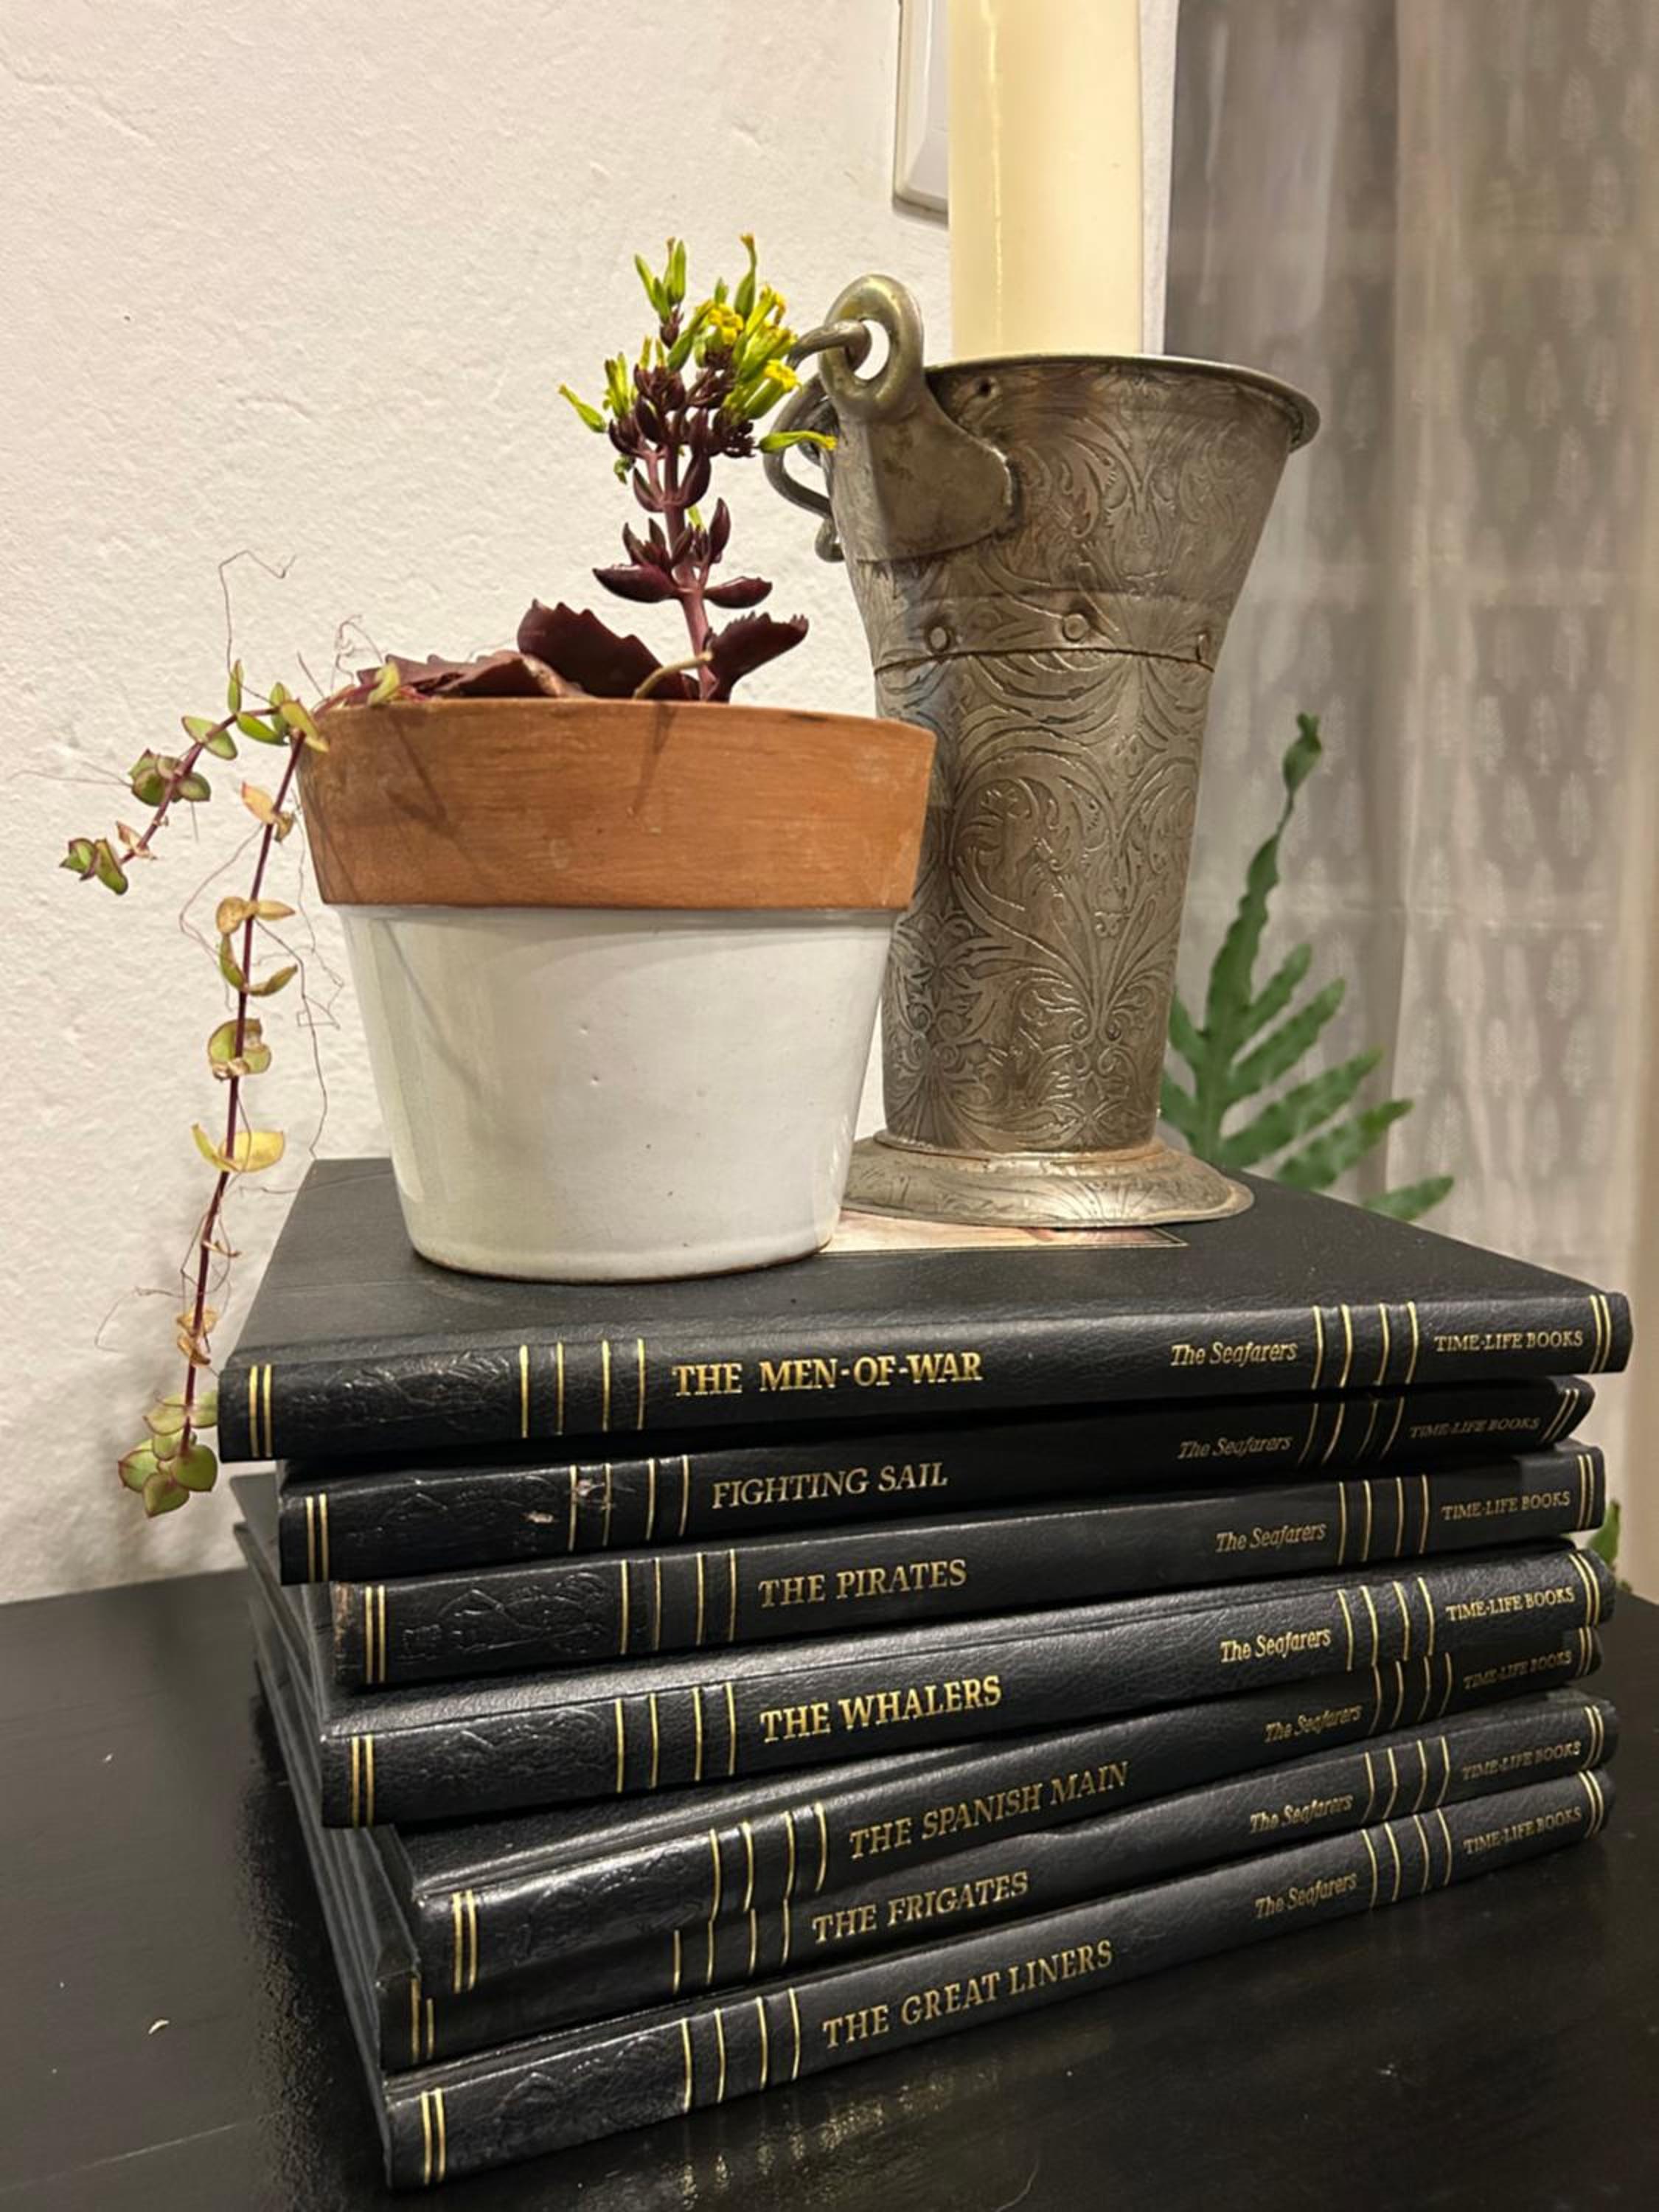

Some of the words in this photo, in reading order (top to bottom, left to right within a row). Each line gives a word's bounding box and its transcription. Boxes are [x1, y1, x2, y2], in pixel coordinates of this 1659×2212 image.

[1171, 1344, 1206, 1366] The
[1210, 1342, 1298, 1367] Seafarers
[1526, 1330, 1583, 1348] BOOKS
[672, 1363, 742, 1397] THE
[759, 1352, 983, 1391] MEN-OF-WAR
[1486, 1416, 1540, 1432] BOOKS
[1178, 1440, 1214, 1459] The
[1217, 1435, 1293, 1458] Seafarers
[712, 1468, 869, 1510] FIGHTING
[878, 1462, 948, 1492] SAIL
[1520, 1491, 1571, 1512] BOOKS
[1216, 1532, 1247, 1553] The
[1250, 1523, 1326, 1548] Seafarers
[759, 1575, 825, 1607] THE
[836, 1559, 967, 1600] PIRATES
[1524, 1587, 1575, 1610] BOOKS
[1220, 1640, 1251, 1664] The
[1255, 1628, 1331, 1659] Seafarers
[1528, 1650, 1573, 1674] BOOKS
[760, 1703, 831, 1743] THE
[838, 1675, 1002, 1731] WHALERS
[1264, 1721, 1293, 1743] The
[1296, 1705, 1362, 1734] Seafarers
[1534, 1741, 1581, 1765] BOOKS
[849, 1820, 912, 1860] THE
[922, 1783, 1044, 1842] SPANISH
[1050, 1761, 1130, 1806] MAIN
[1250, 1812, 1279, 1834] The
[1283, 1794, 1353, 1825] Seafarers
[1537, 1806, 1582, 1833] BOOKS
[813, 1905, 877, 1944] THE
[887, 1871, 1029, 1927] FRIGATES
[1255, 1895, 1284, 1918] The
[1287, 1872, 1357, 1907] Seafarers
[824, 2006, 890, 2049] THE
[901, 1972, 1002, 2025] GREAT
[1009, 1940, 1113, 1995] LINERS
